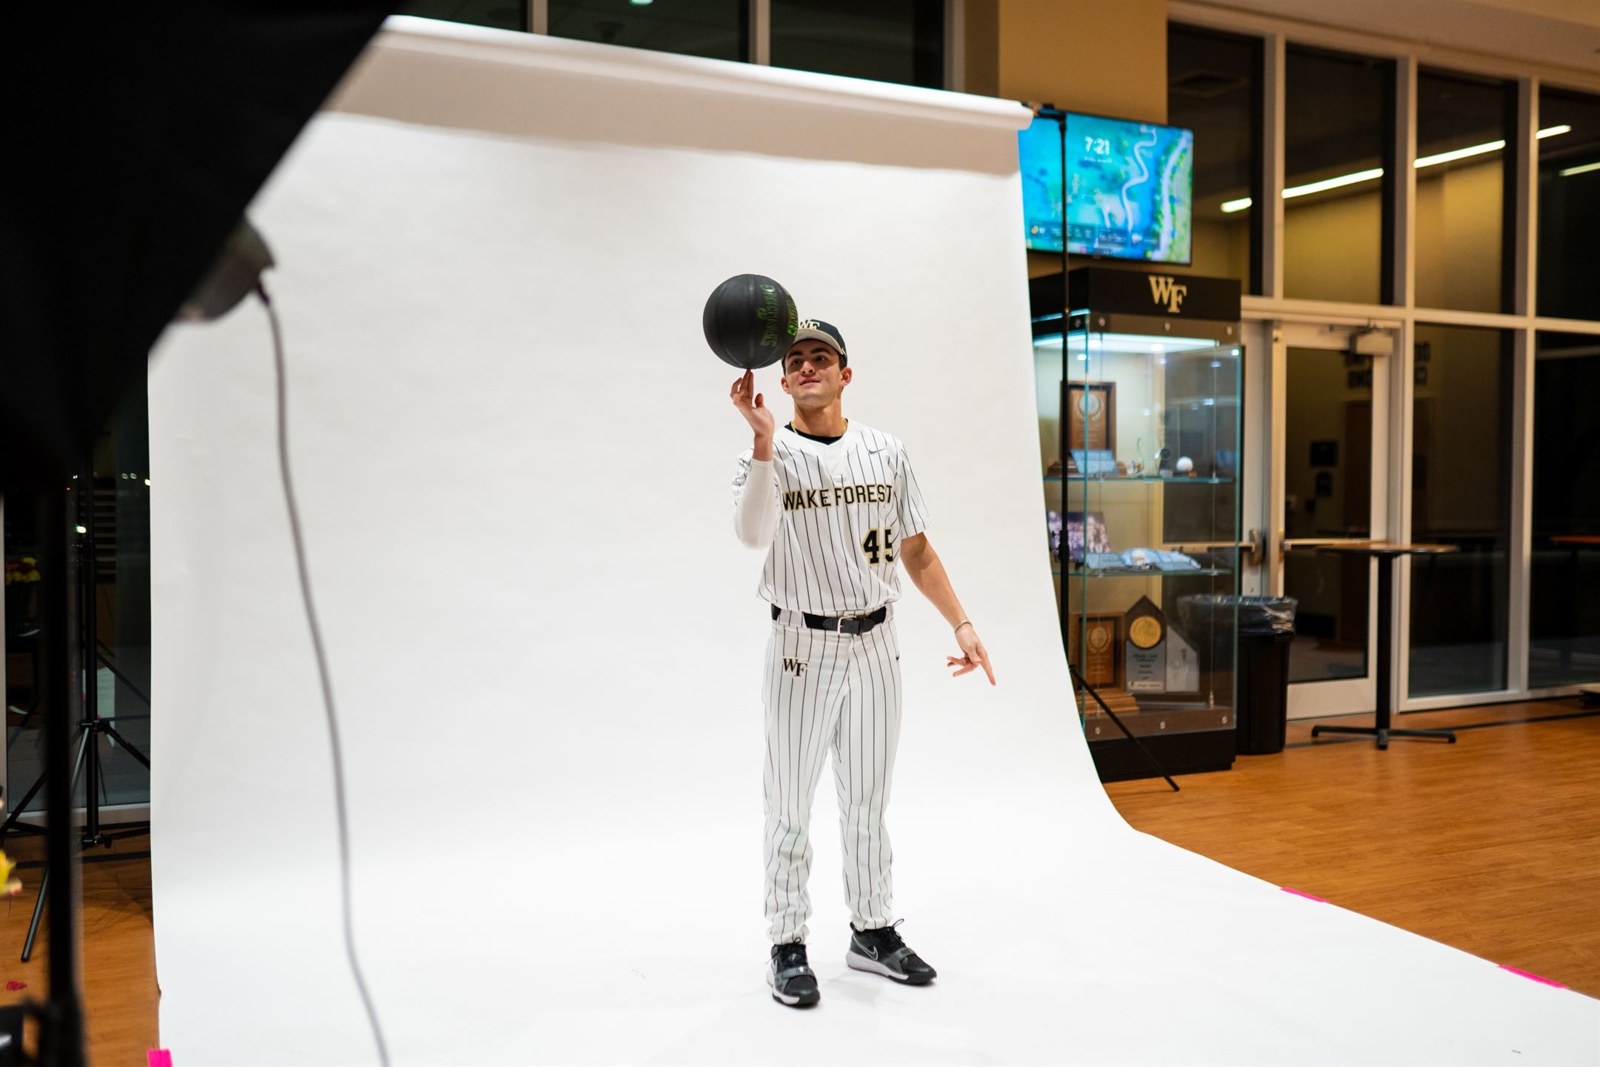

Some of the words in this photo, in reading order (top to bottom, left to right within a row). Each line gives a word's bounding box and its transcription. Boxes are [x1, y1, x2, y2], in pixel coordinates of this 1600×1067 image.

[1084, 135, 1111, 156] 7:21
[1148, 275, 1187, 313] WF
[759, 283, 778, 348] SPALDING
[782, 488, 832, 512] WAKE
[833, 483, 893, 507] FOREST
[862, 527, 894, 567] 45
[782, 656, 808, 678] WF
